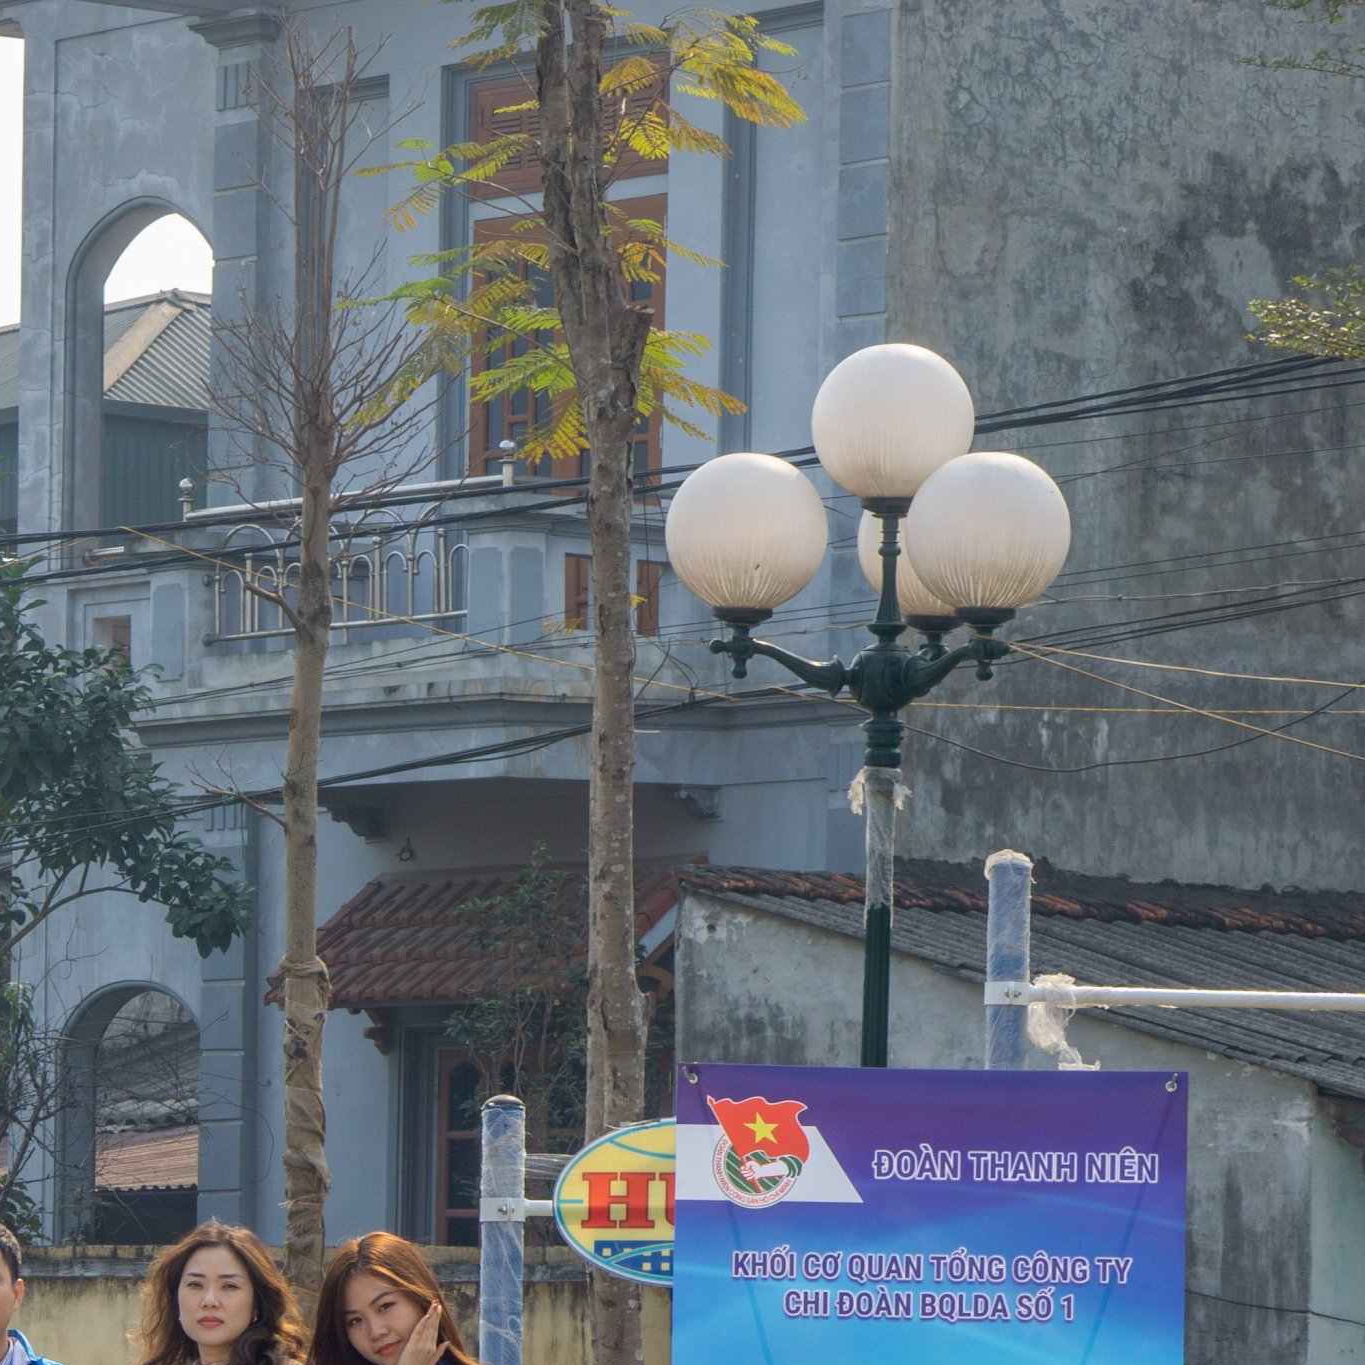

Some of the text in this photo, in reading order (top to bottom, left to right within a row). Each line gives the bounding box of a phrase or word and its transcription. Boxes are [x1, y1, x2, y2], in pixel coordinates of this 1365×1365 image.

[872, 1144, 1158, 1183] ĐOÀN THANH NIÊN
[732, 1244, 1133, 1284] KHỐI CƠ QUAN TỔNG CÔNG TY
[784, 1286, 1074, 1323] CHI ĐOÀN BQLDA SỐ 1
